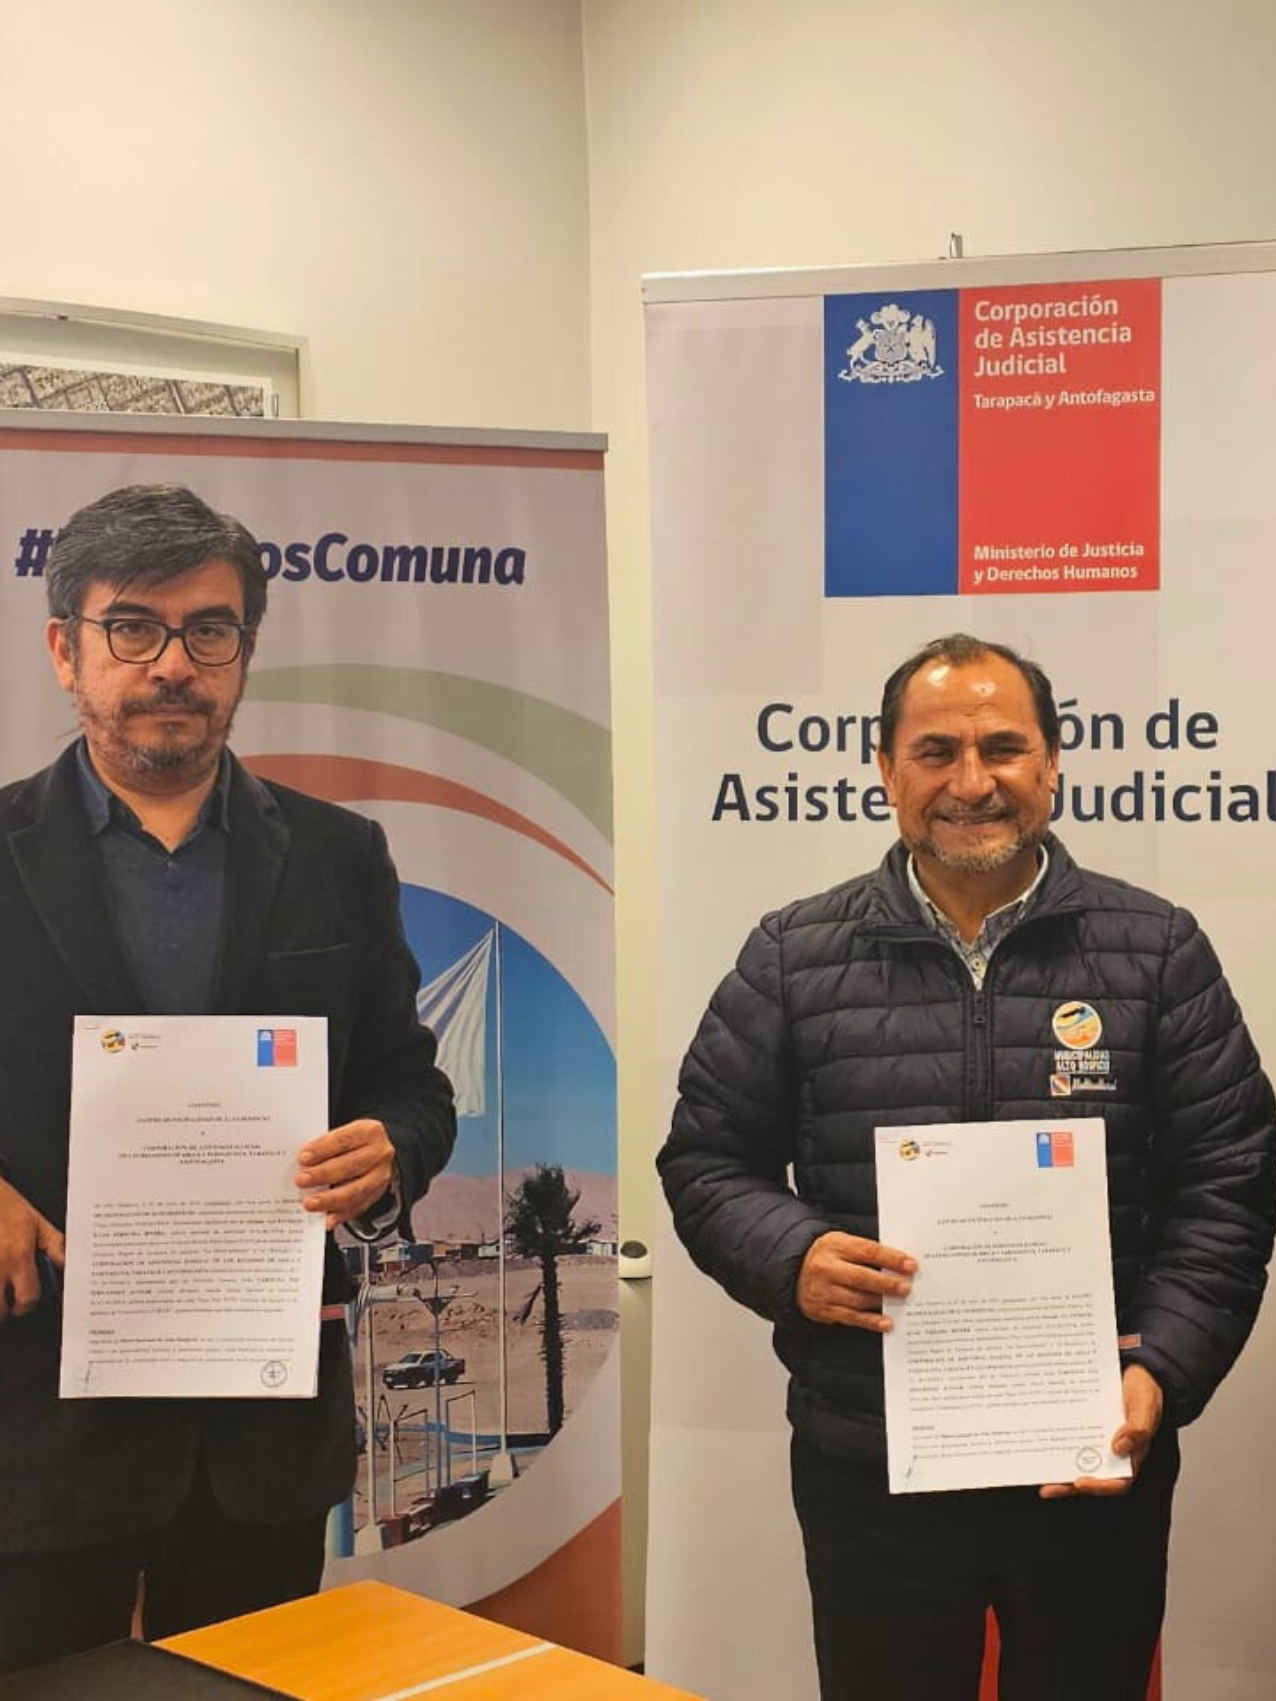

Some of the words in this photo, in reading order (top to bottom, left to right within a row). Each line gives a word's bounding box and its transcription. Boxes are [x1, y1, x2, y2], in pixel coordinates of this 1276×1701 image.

[974, 294, 1119, 325] Corporación
[974, 328, 1004, 348] de
[1009, 322, 1132, 348] Asistencia
[974, 352, 1067, 378] Judicial
[974, 391, 1042, 410] Tarapacá
[1044, 394, 1055, 410] y
[1059, 388, 1156, 406] Antofagasta
[974, 544, 1056, 560] Ministerio
[1059, 543, 1078, 557] de
[1082, 542, 1145, 558] Justicia
[974, 568, 983, 585] y
[987, 565, 1060, 581] Derechos
[1064, 565, 1139, 579] Humanos
[757, 697, 1125, 765] Corpón
[1145, 698, 1219, 751] de
